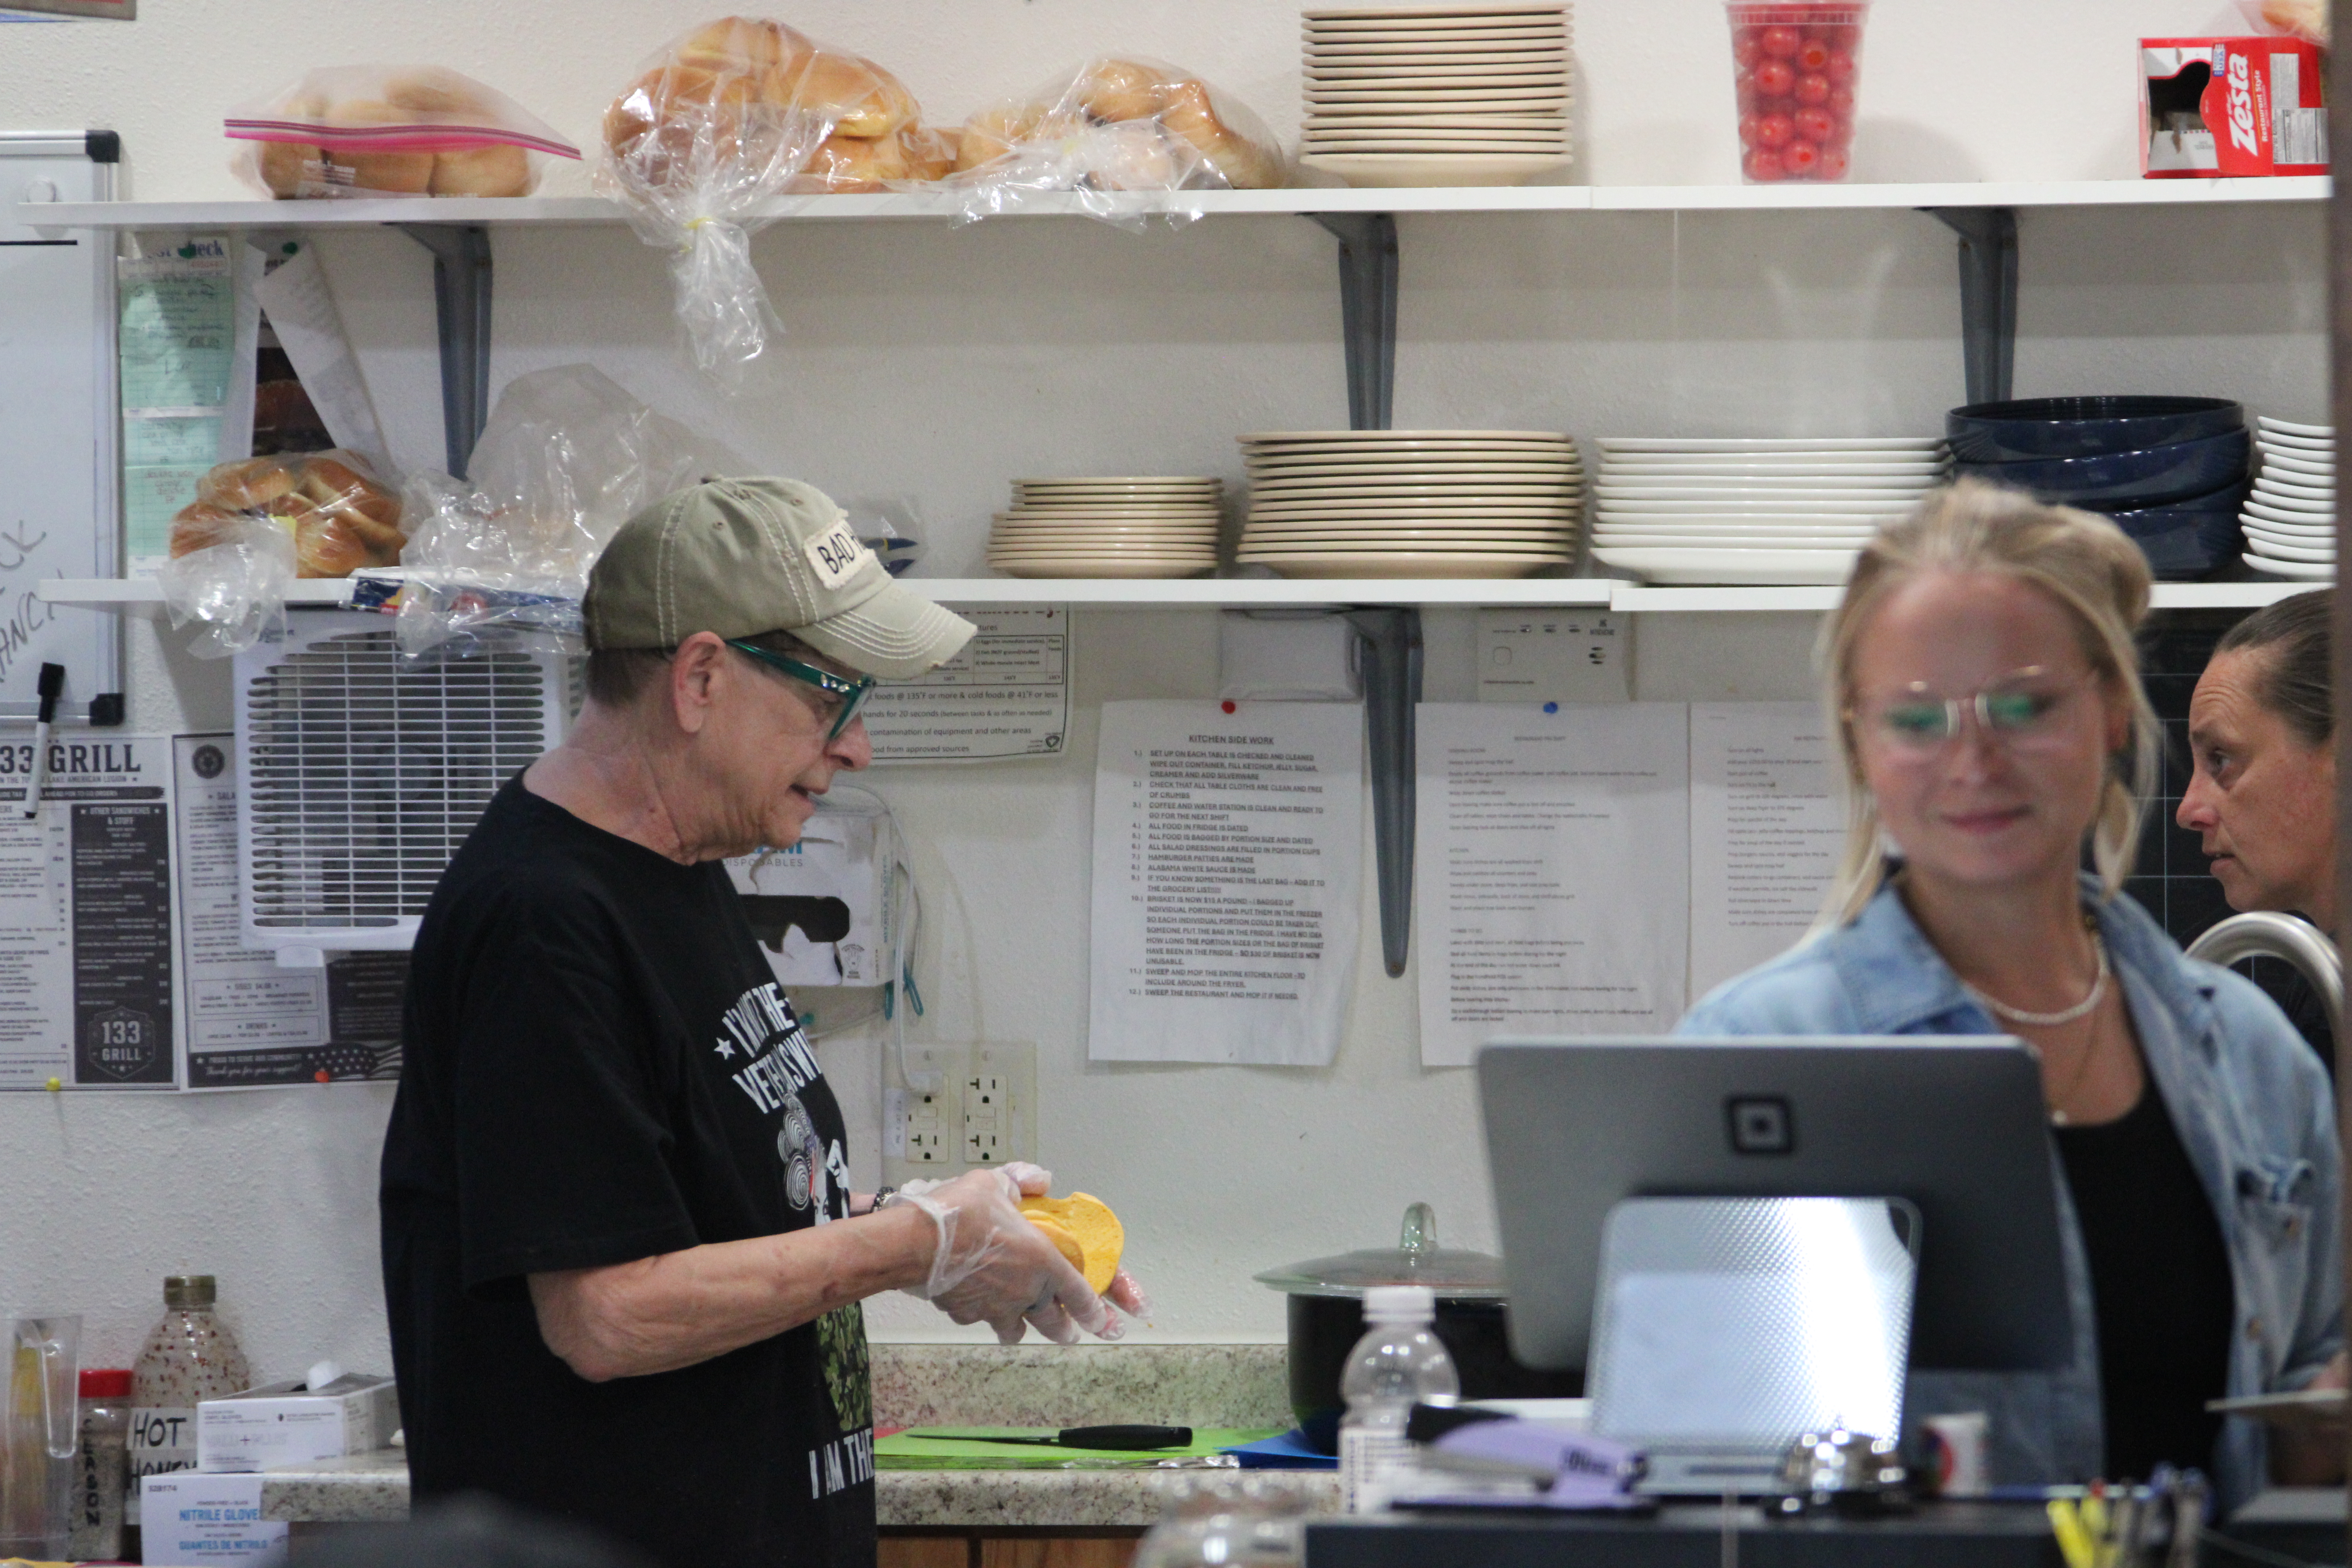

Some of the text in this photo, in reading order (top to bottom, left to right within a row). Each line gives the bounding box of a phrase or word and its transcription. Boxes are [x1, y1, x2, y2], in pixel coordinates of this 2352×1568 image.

[2227, 53, 2258, 156] Zesta
[2257, 93, 2269, 142] Restaurant
[817, 533, 855, 574] BAD
[1189, 735, 1226, 743] KITCHEN
[48, 744, 141, 773] GRILL
[102, 1021, 141, 1044] 133
[102, 1048, 142, 1061] GRILL
[132, 1412, 187, 1448] HOT
[809, 1450, 819, 1499] I
[843, 1428, 875, 1485] THE
[179, 1508, 259, 1521] NITRILE GLOVE
